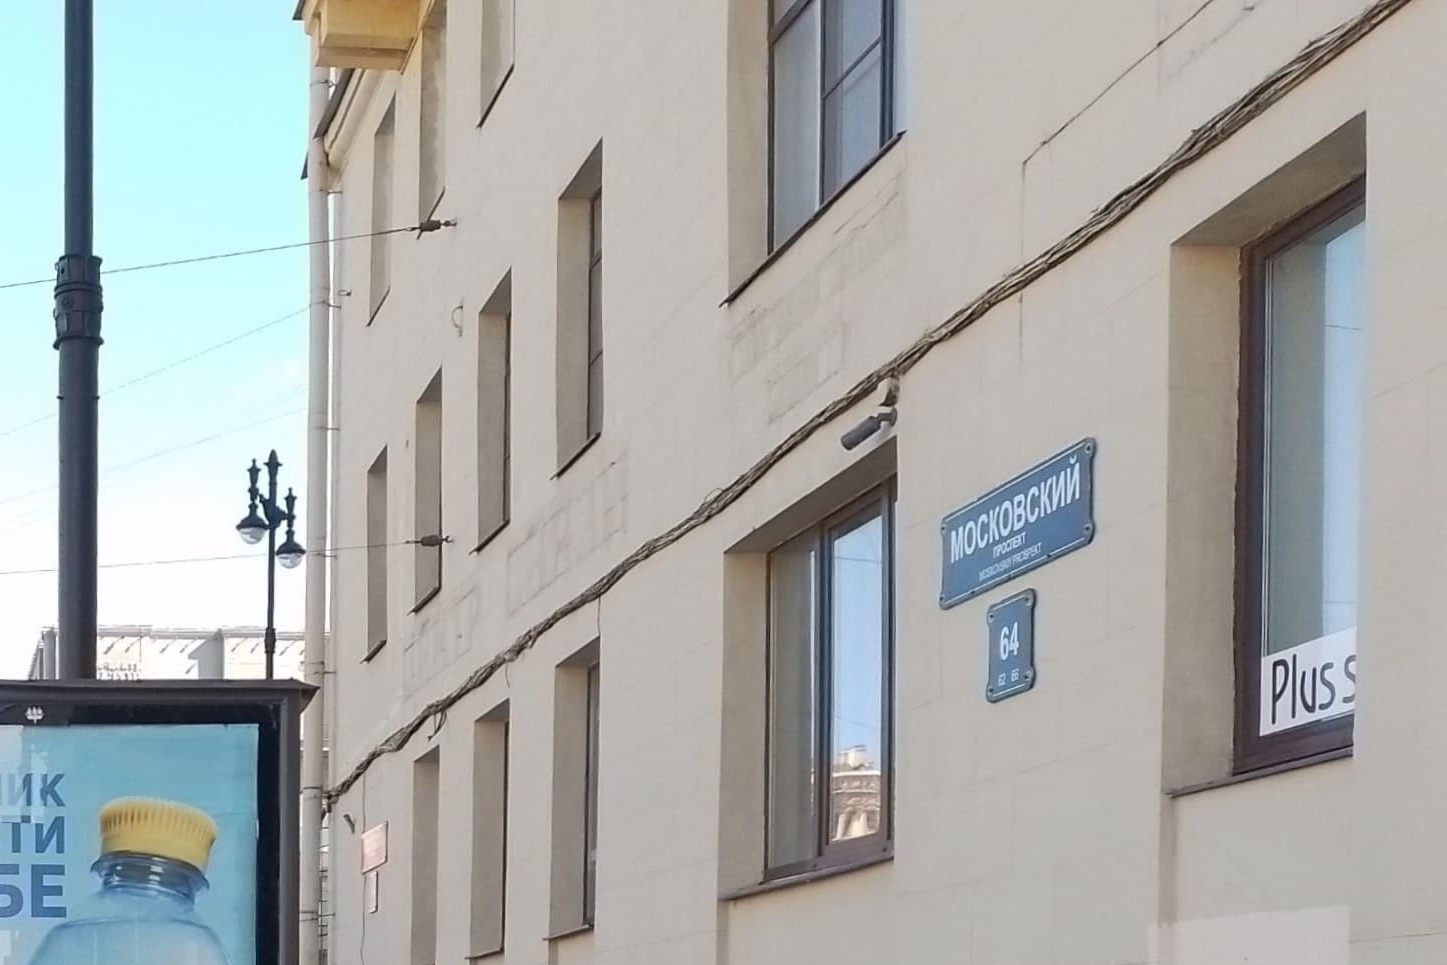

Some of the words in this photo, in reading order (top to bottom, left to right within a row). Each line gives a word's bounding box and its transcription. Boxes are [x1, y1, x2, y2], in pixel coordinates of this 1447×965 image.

[950, 454, 1081, 564] МОСКОВСКИЙ
[992, 531, 1027, 559] ПРОСПЕКТ
[1000, 621, 1020, 660] 64
[1271, 653, 1336, 726] Plus
